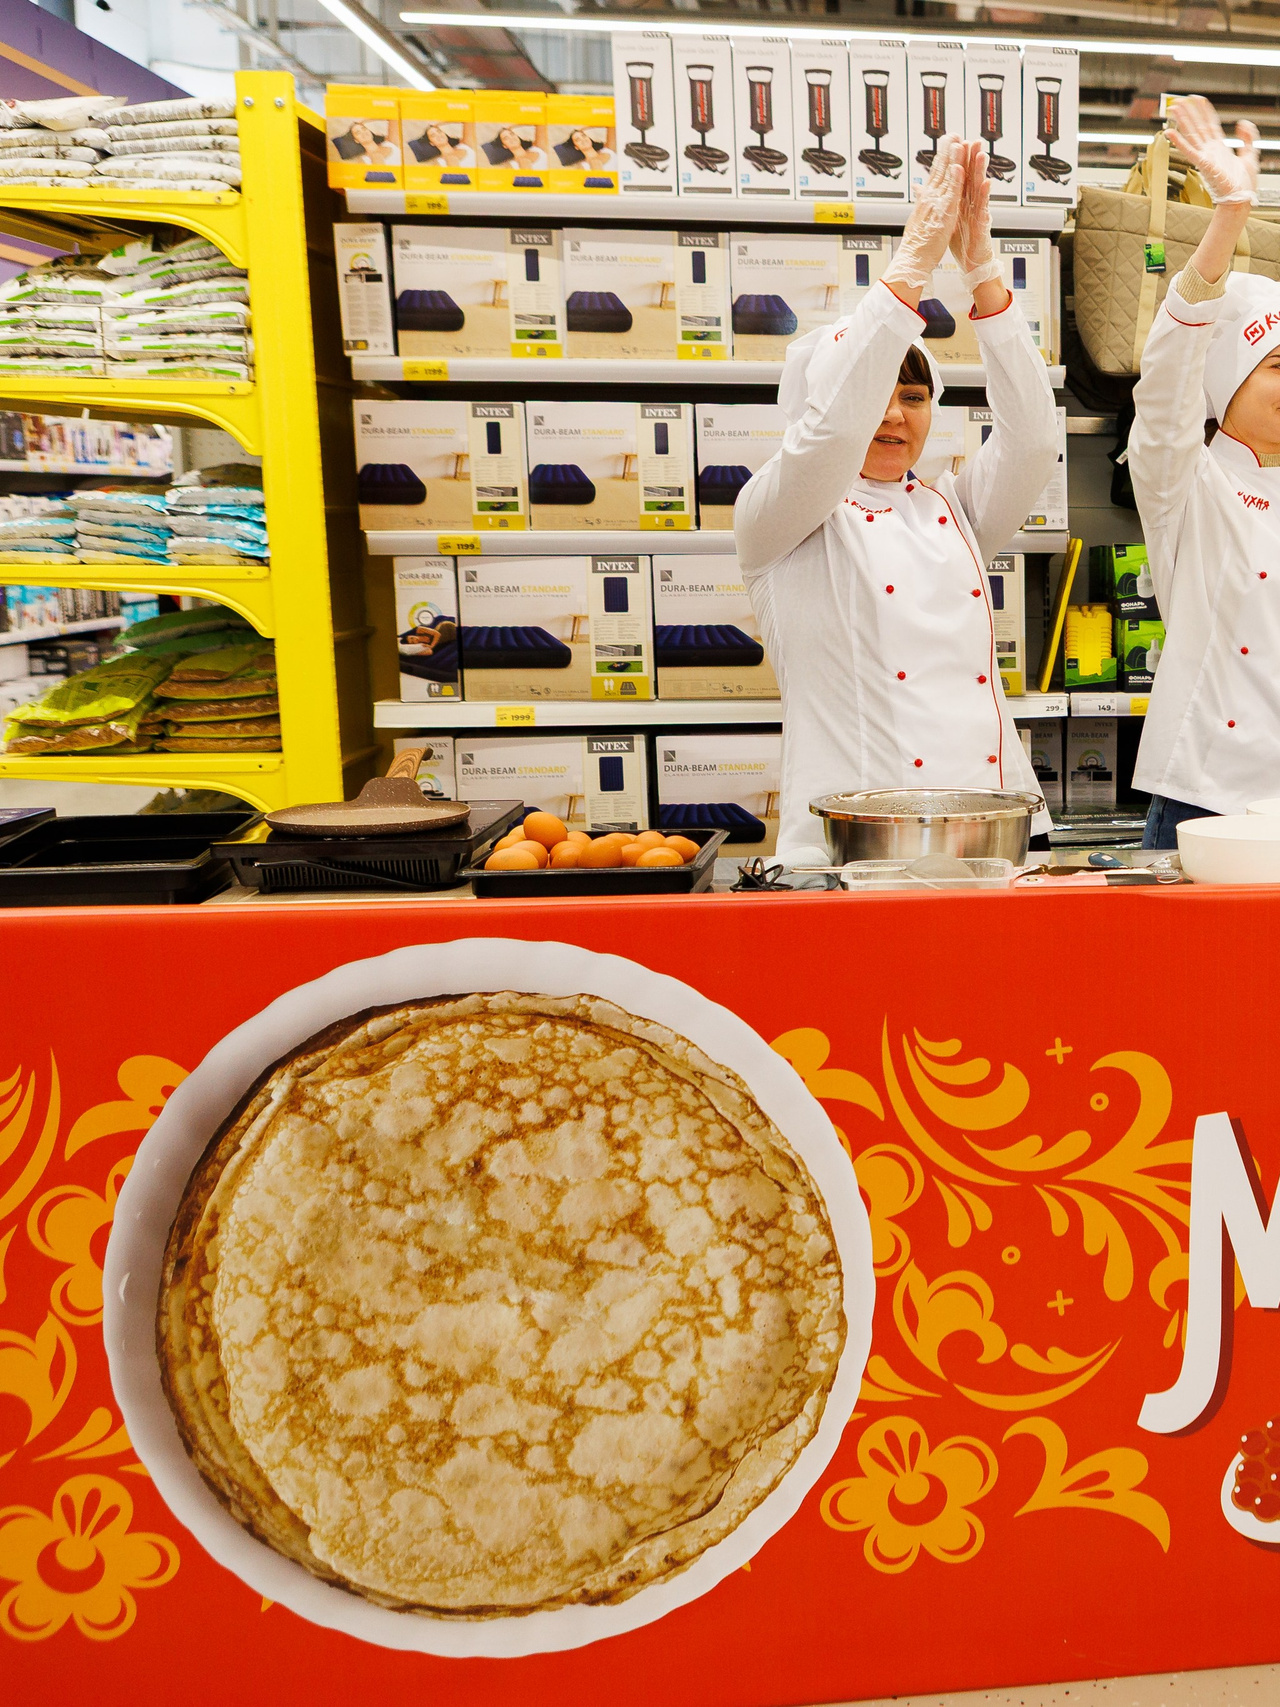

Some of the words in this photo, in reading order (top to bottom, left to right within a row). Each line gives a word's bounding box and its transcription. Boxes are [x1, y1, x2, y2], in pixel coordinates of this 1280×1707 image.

[514, 233, 547, 243] INTEX
[682, 236, 715, 246] INTEX
[846, 239, 878, 249] INTEX
[1003, 243, 1036, 252] INTEX
[737, 258, 784, 266] DURA-BEAM
[475, 407, 511, 417] INTEX
[644, 408, 678, 417] INTEX
[533, 428, 581, 436] DURA-BEAM
[596, 561, 635, 571] INTEX
[465, 585, 520, 593] DURA-BEAM
[521, 585, 571, 593] STANDARD
[660, 584, 715, 592] DURA-BEAM
[592, 741, 630, 751] INTEX
[461, 766, 517, 775] DURA-BEAM
[517, 765, 567, 774] STANDARD
[663, 763, 717, 772] DURA-BEAM
[718, 762, 766, 771] STANDARD
